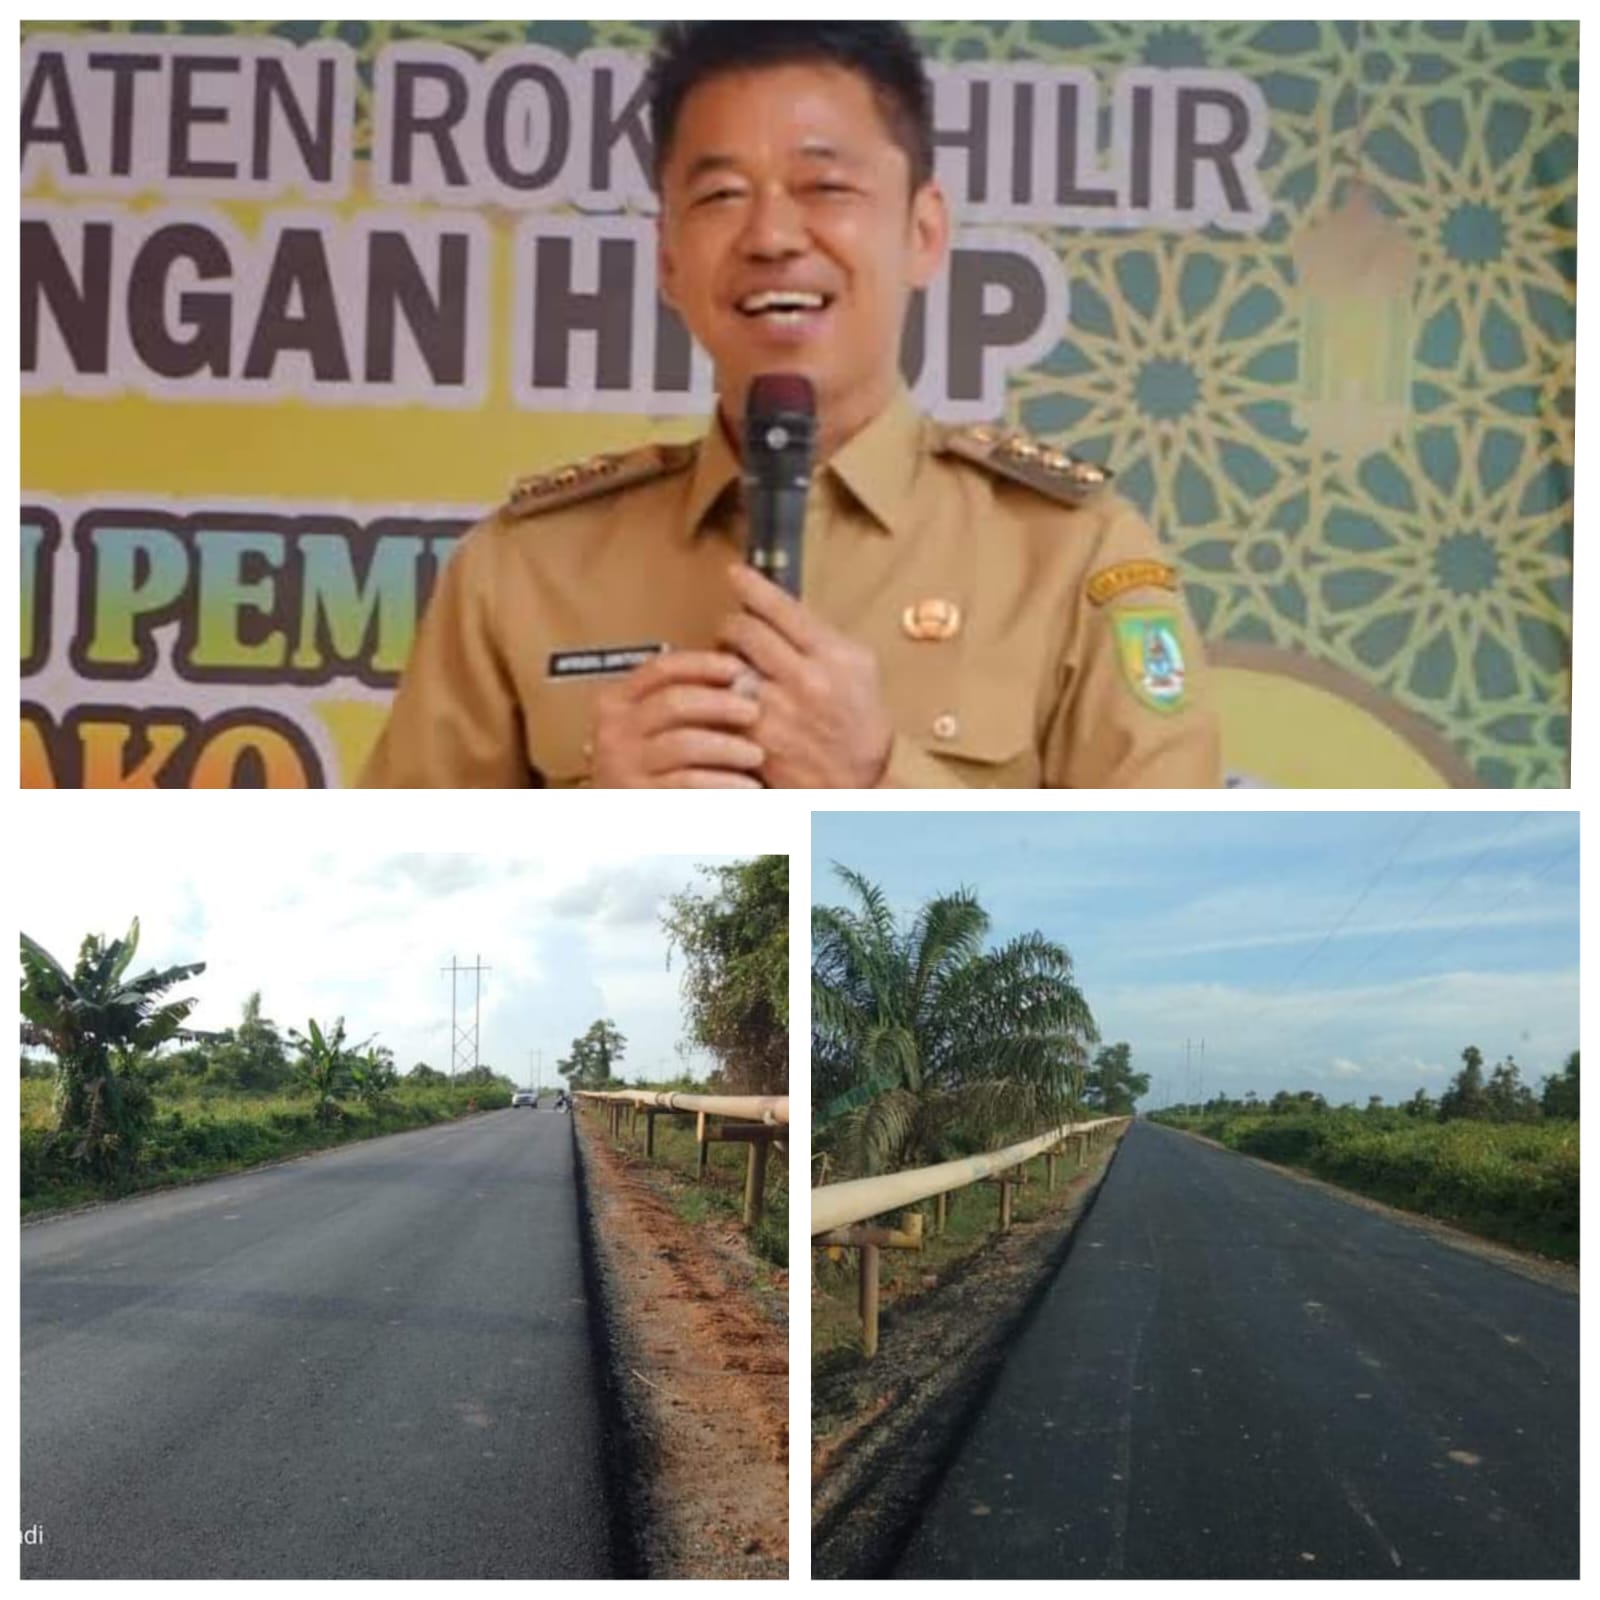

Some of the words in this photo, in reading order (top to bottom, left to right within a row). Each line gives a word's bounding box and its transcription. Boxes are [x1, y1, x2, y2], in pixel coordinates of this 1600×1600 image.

[20, 52, 336, 183] ATEN
[927, 79, 1254, 213] HILIR
[20, 220, 471, 387] NGAN
[82, 520, 468, 676] PEM
